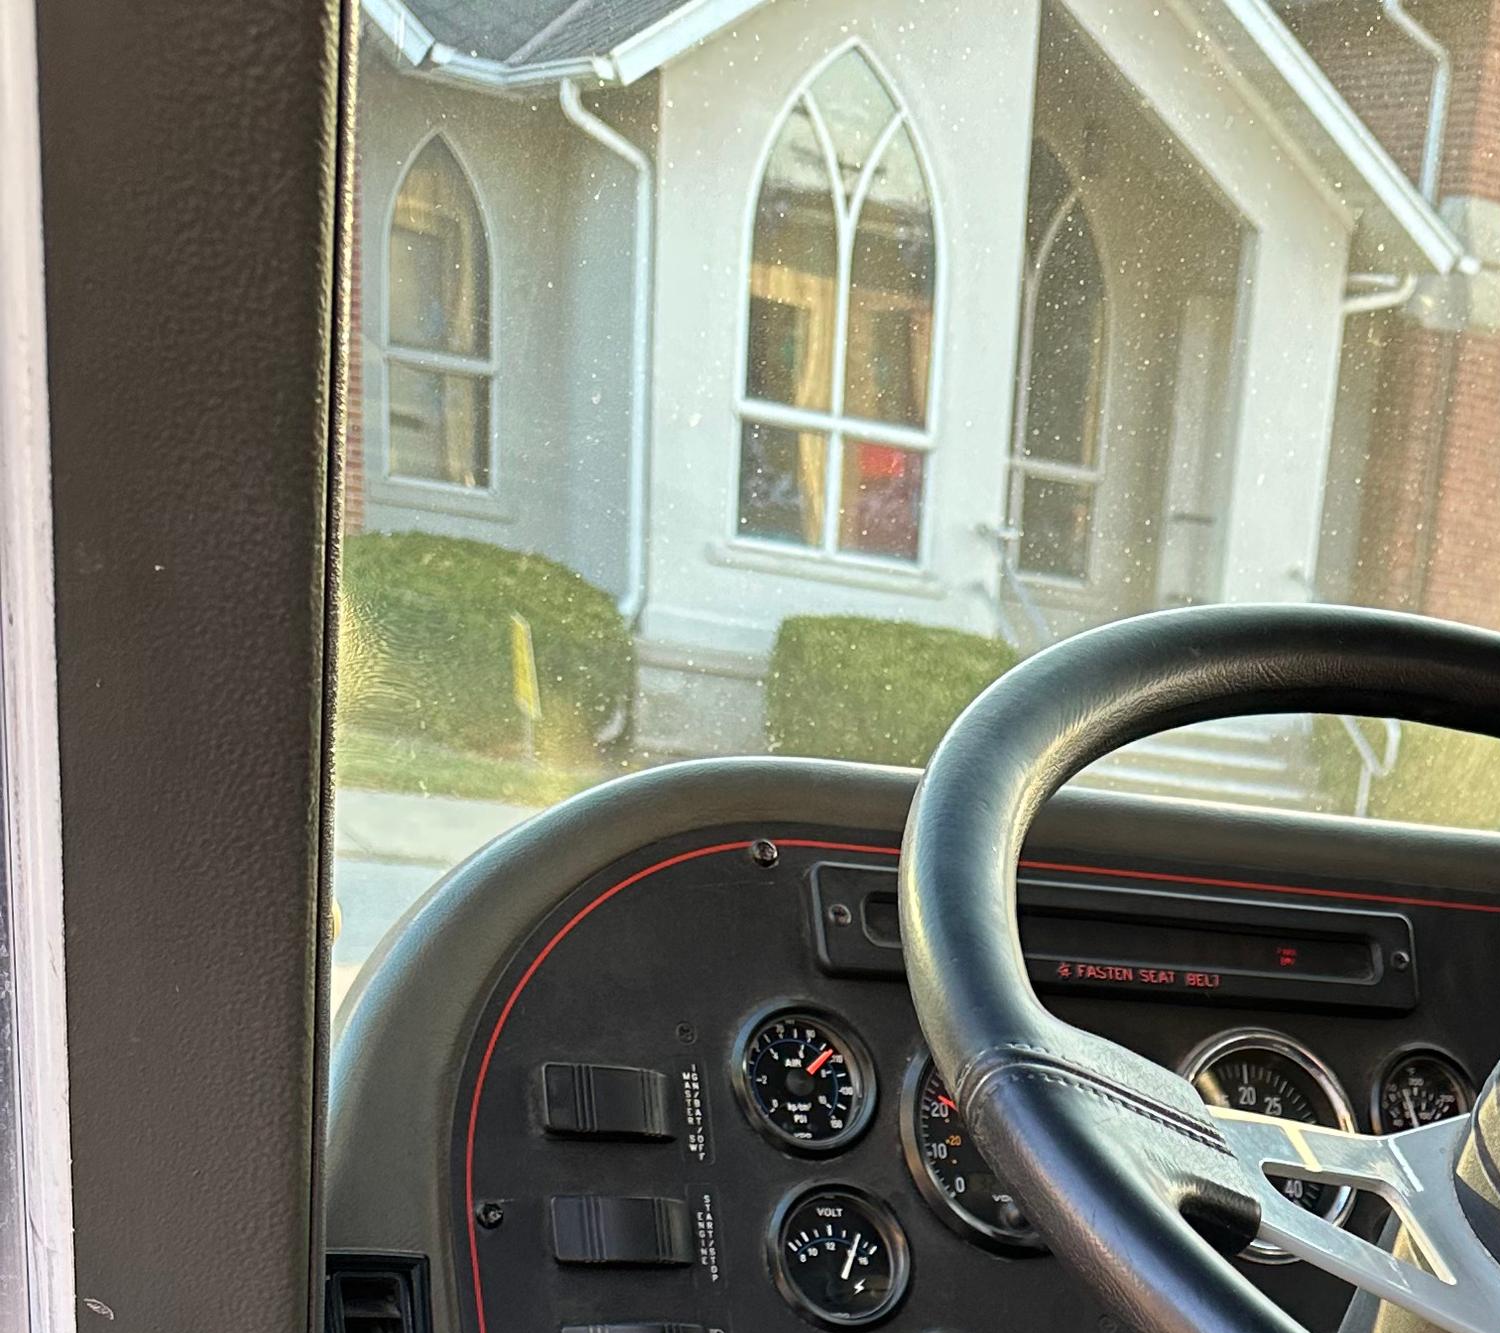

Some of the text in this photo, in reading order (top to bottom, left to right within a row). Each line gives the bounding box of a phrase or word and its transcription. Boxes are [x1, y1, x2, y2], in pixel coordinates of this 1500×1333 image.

[1077, 965, 1219, 988] FASTEN SEAT BELT
[785, 1058, 802, 1068] AIR
[682, 1072, 695, 1125] MASTER
[1238, 1087, 1283, 1116] 20 25
[931, 1103, 949, 1118] 20
[950, 1135, 962, 1146] 20
[931, 1143, 948, 1160] 10
[955, 1176, 966, 1193] 0
[1285, 1181, 1303, 1198] 40
[816, 1207, 843, 1218] VOLT
[696, 1211, 708, 1265] ENGINE
[703, 1194, 719, 1283] START/STOP
[825, 1242, 836, 1251] 12
